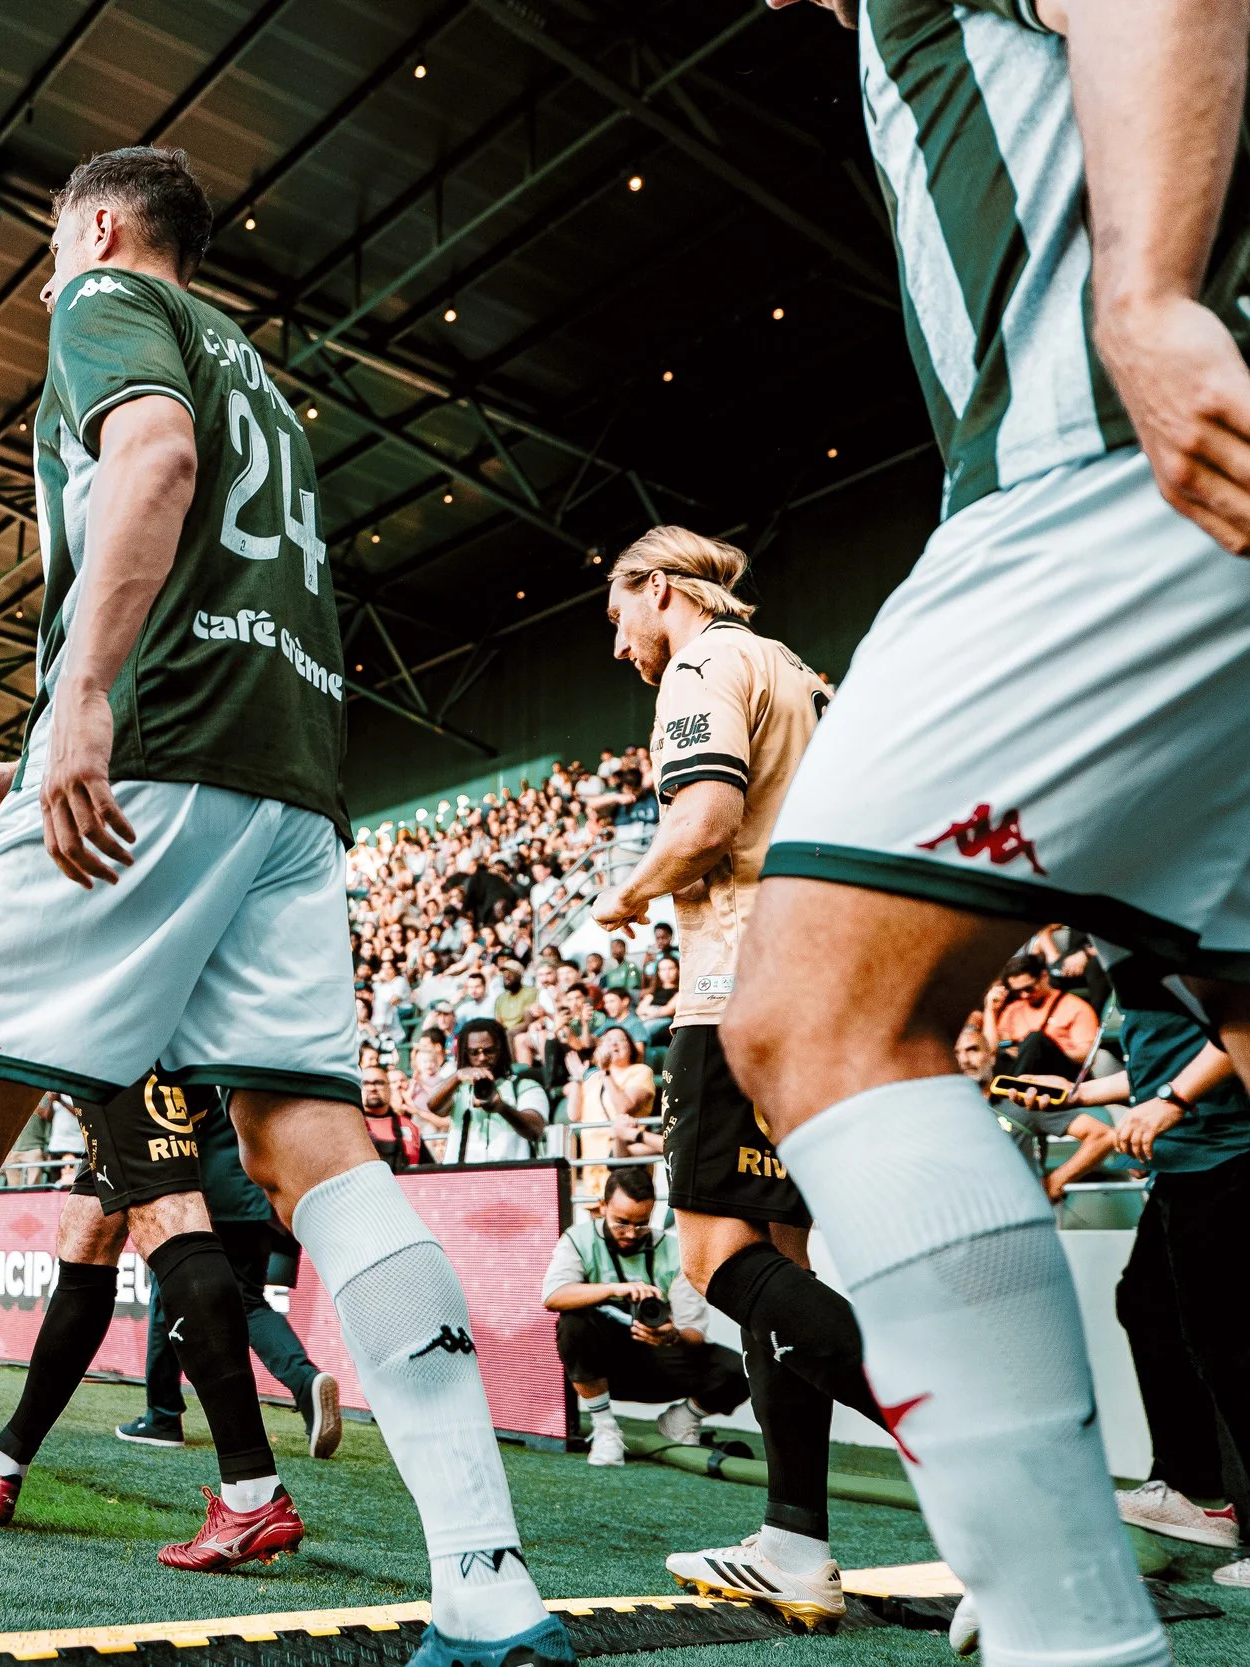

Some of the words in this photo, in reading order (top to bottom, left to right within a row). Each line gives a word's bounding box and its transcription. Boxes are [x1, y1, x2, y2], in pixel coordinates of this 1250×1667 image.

[220, 388, 327, 596] 24
[193, 609, 276, 647] café
[281, 628, 343, 702] crème
[666, 712, 711, 737] DEUX
[677, 733, 711, 749] ONS
[148, 1135, 198, 1162] Rive
[738, 1146, 787, 1180] Riv
